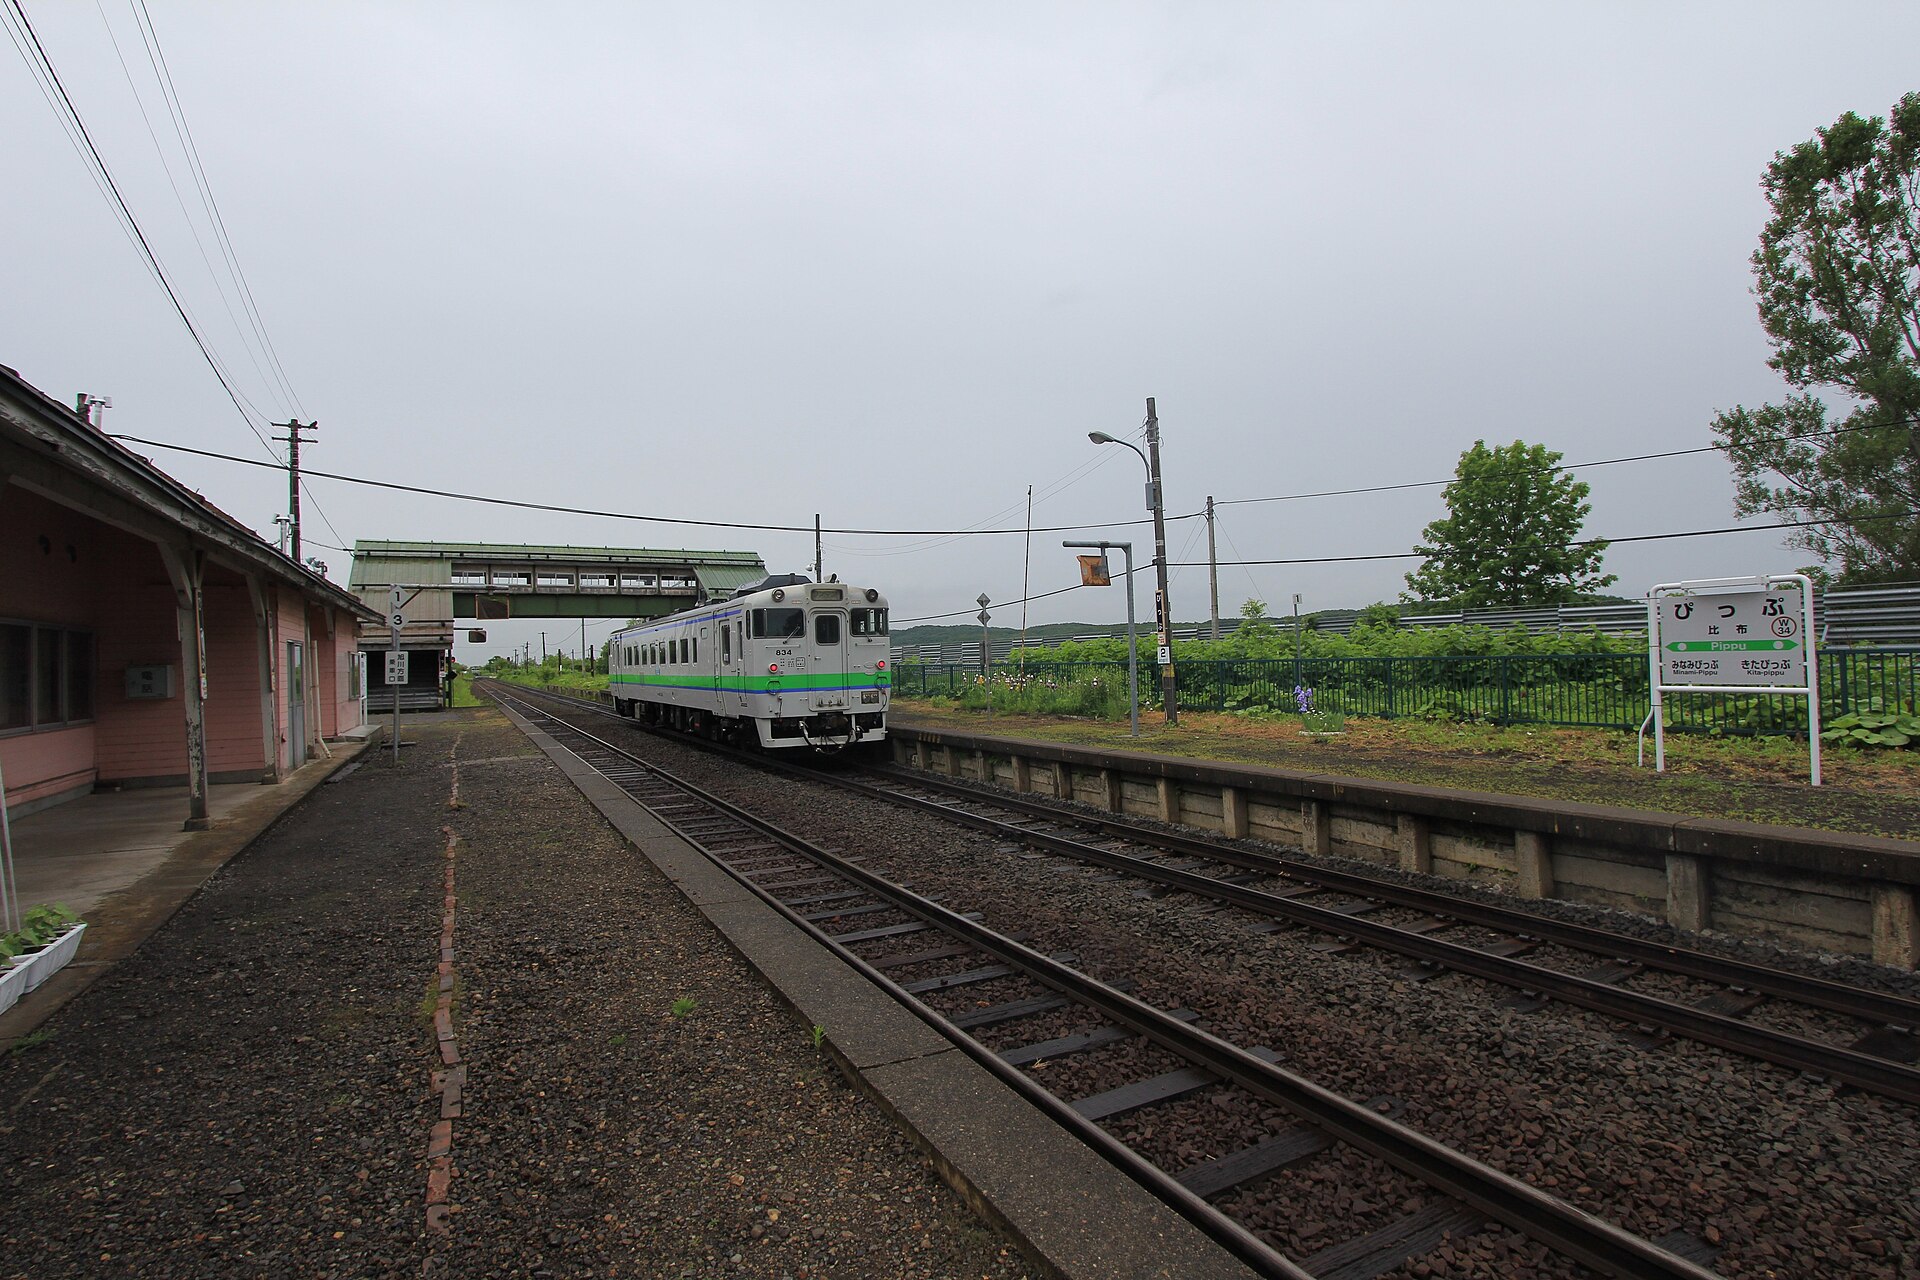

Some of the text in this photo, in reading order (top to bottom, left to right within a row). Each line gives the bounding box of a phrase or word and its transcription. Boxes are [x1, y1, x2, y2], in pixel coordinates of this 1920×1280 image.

[394, 591, 400, 602] 1
[1674, 597, 1785, 620] ぴっぷ
[393, 614, 403, 625] 3
[1778, 619, 1789, 627] W
[1708, 624, 1748, 635] 比布
[1777, 626, 1791, 635] 34
[1711, 641, 1747, 651] Pippu
[1160, 647, 1166, 658] 2
